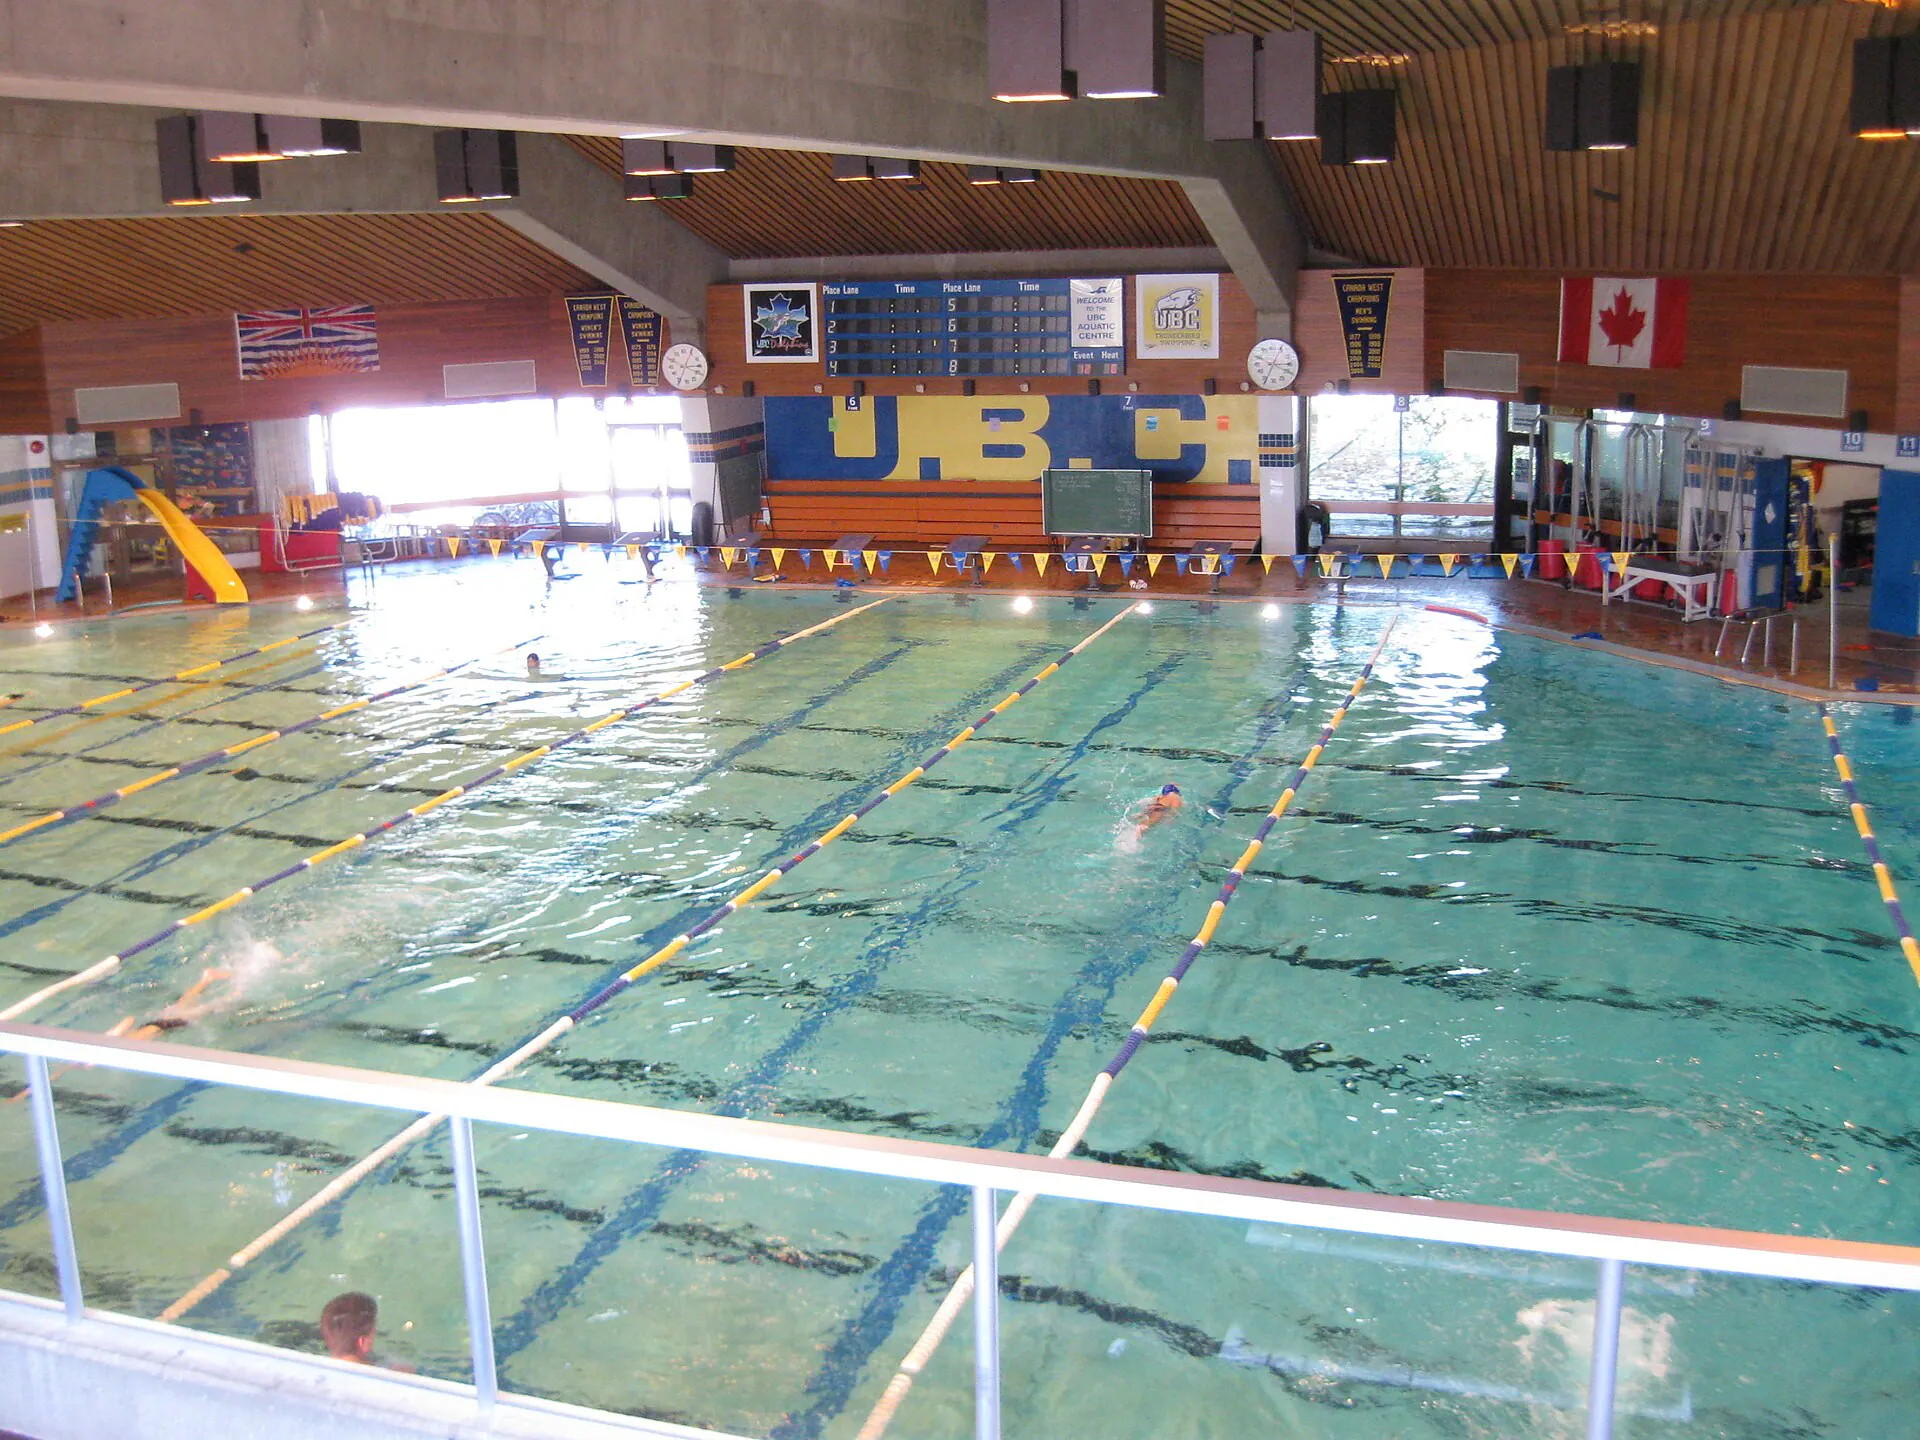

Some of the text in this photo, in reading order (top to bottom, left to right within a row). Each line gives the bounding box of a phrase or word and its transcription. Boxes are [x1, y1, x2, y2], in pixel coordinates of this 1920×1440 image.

[822, 284, 859, 295] Place Lane
[894, 283, 916, 294] Time
[943, 282, 981, 293] Place Lane
[1018, 281, 1040, 291] Time
[947, 298, 956, 312] 5
[1076, 297, 1116, 305] WELCOME
[1086, 313, 1106, 321] UBC
[1153, 308, 1200, 330] UBC
[827, 320, 837, 334] 2
[947, 318, 957, 332] 6
[1077, 323, 1116, 331] AQUATIC
[1078, 332, 1115, 340] CENTRE
[829, 340, 837, 354] 3
[949, 339, 957, 352] 7
[1073, 350, 1119, 360] Event Heat
[829, 360, 838, 374] 4
[949, 360, 958, 373] 8
[849, 396, 856, 406] 6
[1124, 395, 1131, 405] 7
[1398, 396, 1405, 407] 8
[1700, 418, 1709, 431] 9
[1844, 432, 1861, 445] 10
[1901, 437, 1914, 450] 11
